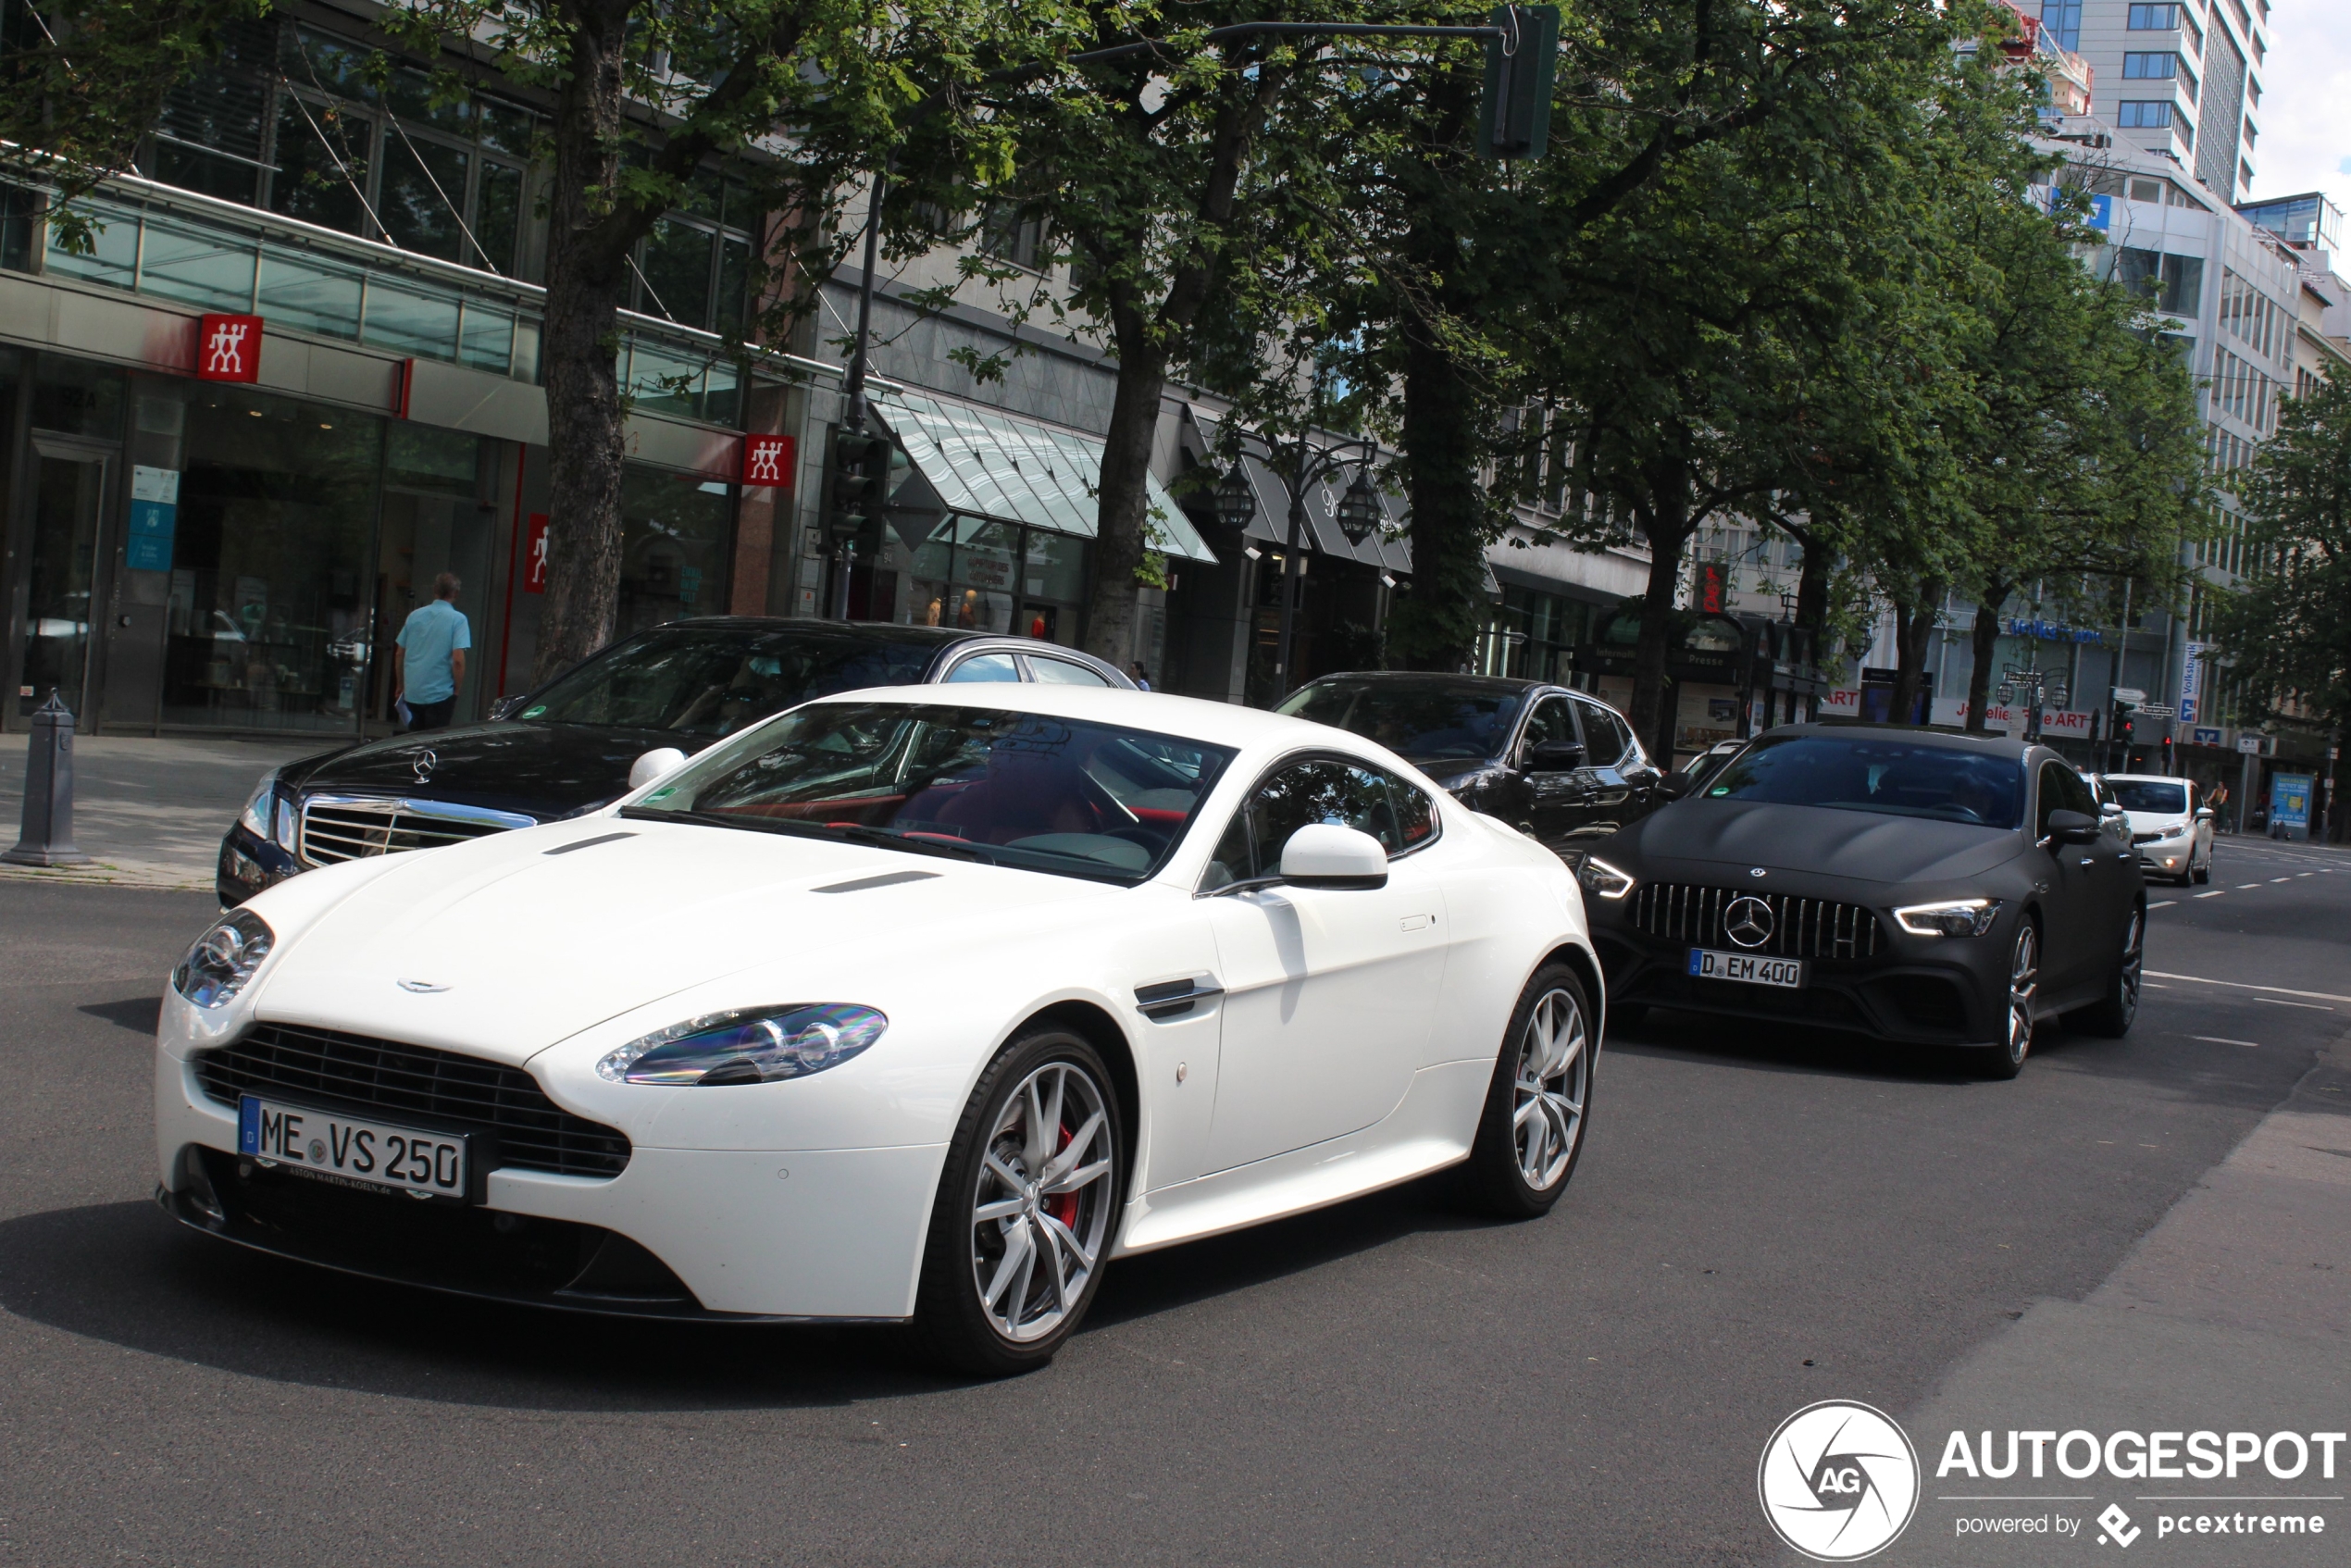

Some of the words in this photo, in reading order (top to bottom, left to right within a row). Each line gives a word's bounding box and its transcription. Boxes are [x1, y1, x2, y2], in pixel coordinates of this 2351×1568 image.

[884, 553, 892, 563] 94
[2009, 617, 2103, 646] Volksank
[1689, 654, 1723, 666] Presse
[2183, 644, 2196, 694] Volksbank
[2055, 713, 2088, 728] ART
[1702, 953, 1715, 975] D
[1727, 957, 1754, 979] EM
[1759, 962, 1797, 985] 400
[261, 1109, 304, 1160] ME
[330, 1123, 375, 1174] VS
[385, 1135, 457, 1188] 250
[289, 1167, 316, 1179] ASTON
